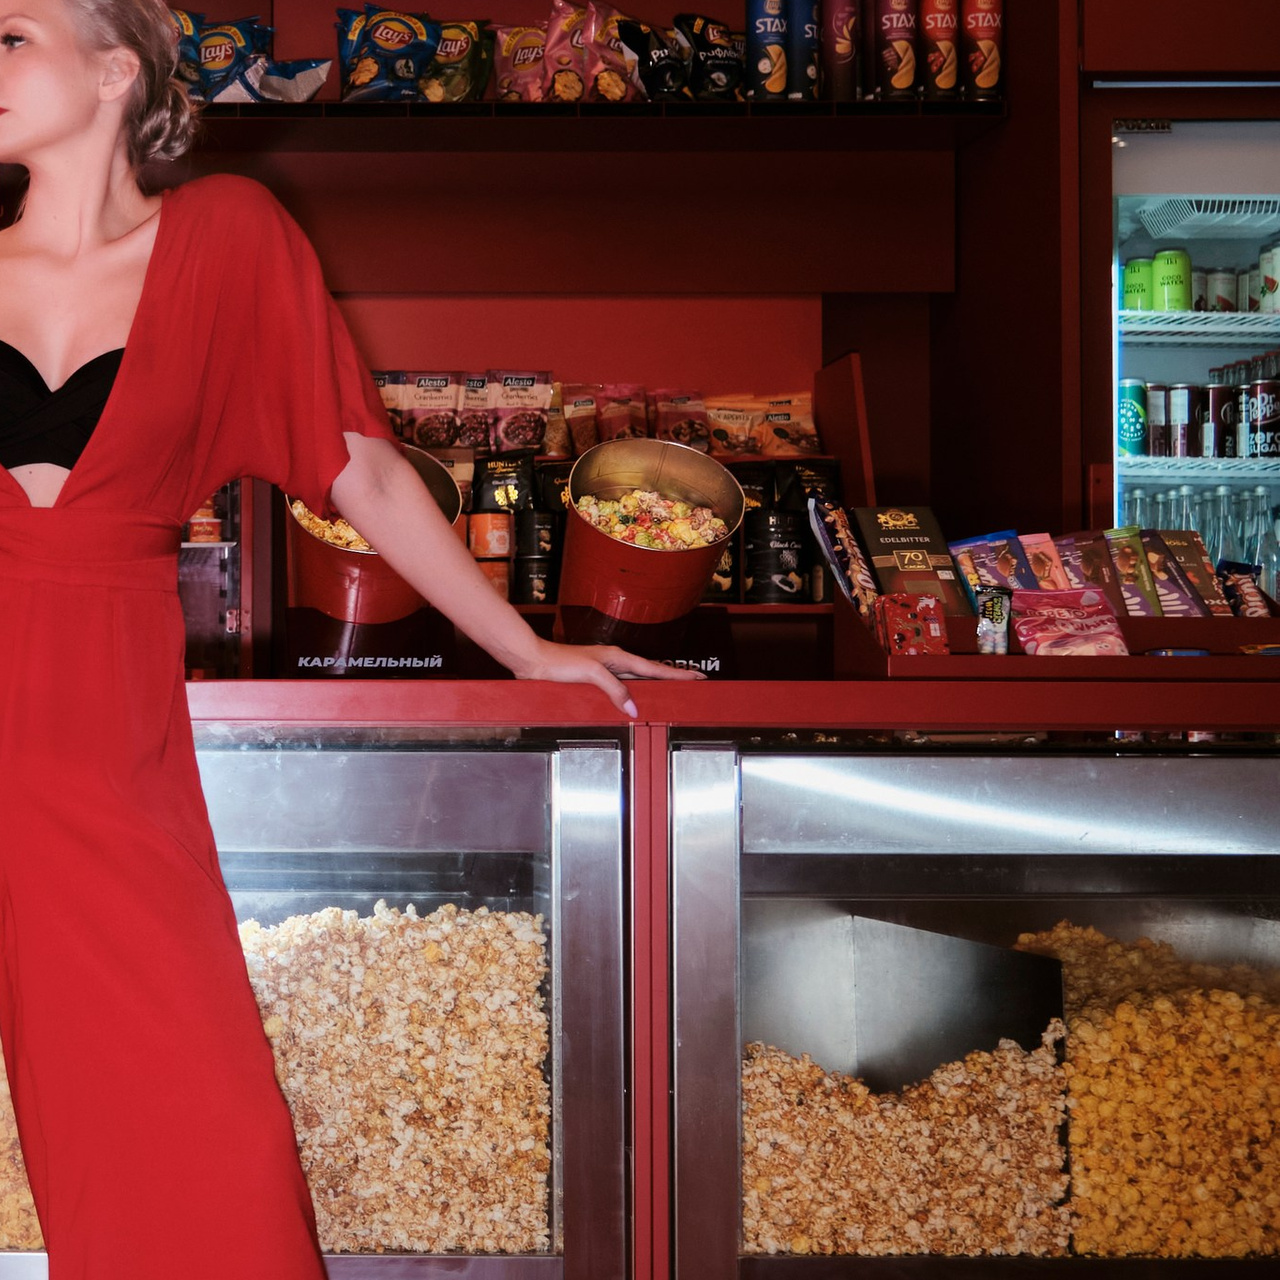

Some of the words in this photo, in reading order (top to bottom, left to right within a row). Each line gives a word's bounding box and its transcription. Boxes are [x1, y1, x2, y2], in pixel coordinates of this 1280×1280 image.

[755, 17, 788, 34] STAX
[881, 13, 916, 30] STAX
[925, 14, 958, 30] STAX
[967, 13, 1002, 30] STAX
[372, 23, 414, 45] Lay's
[418, 377, 447, 388] Alesto
[504, 376, 533, 387] Alesto
[879, 536, 931, 544] EDELBITTER
[900, 552, 923, 565] 70
[297, 654, 443, 669] КАРАМЕЛЬНЫЙ
